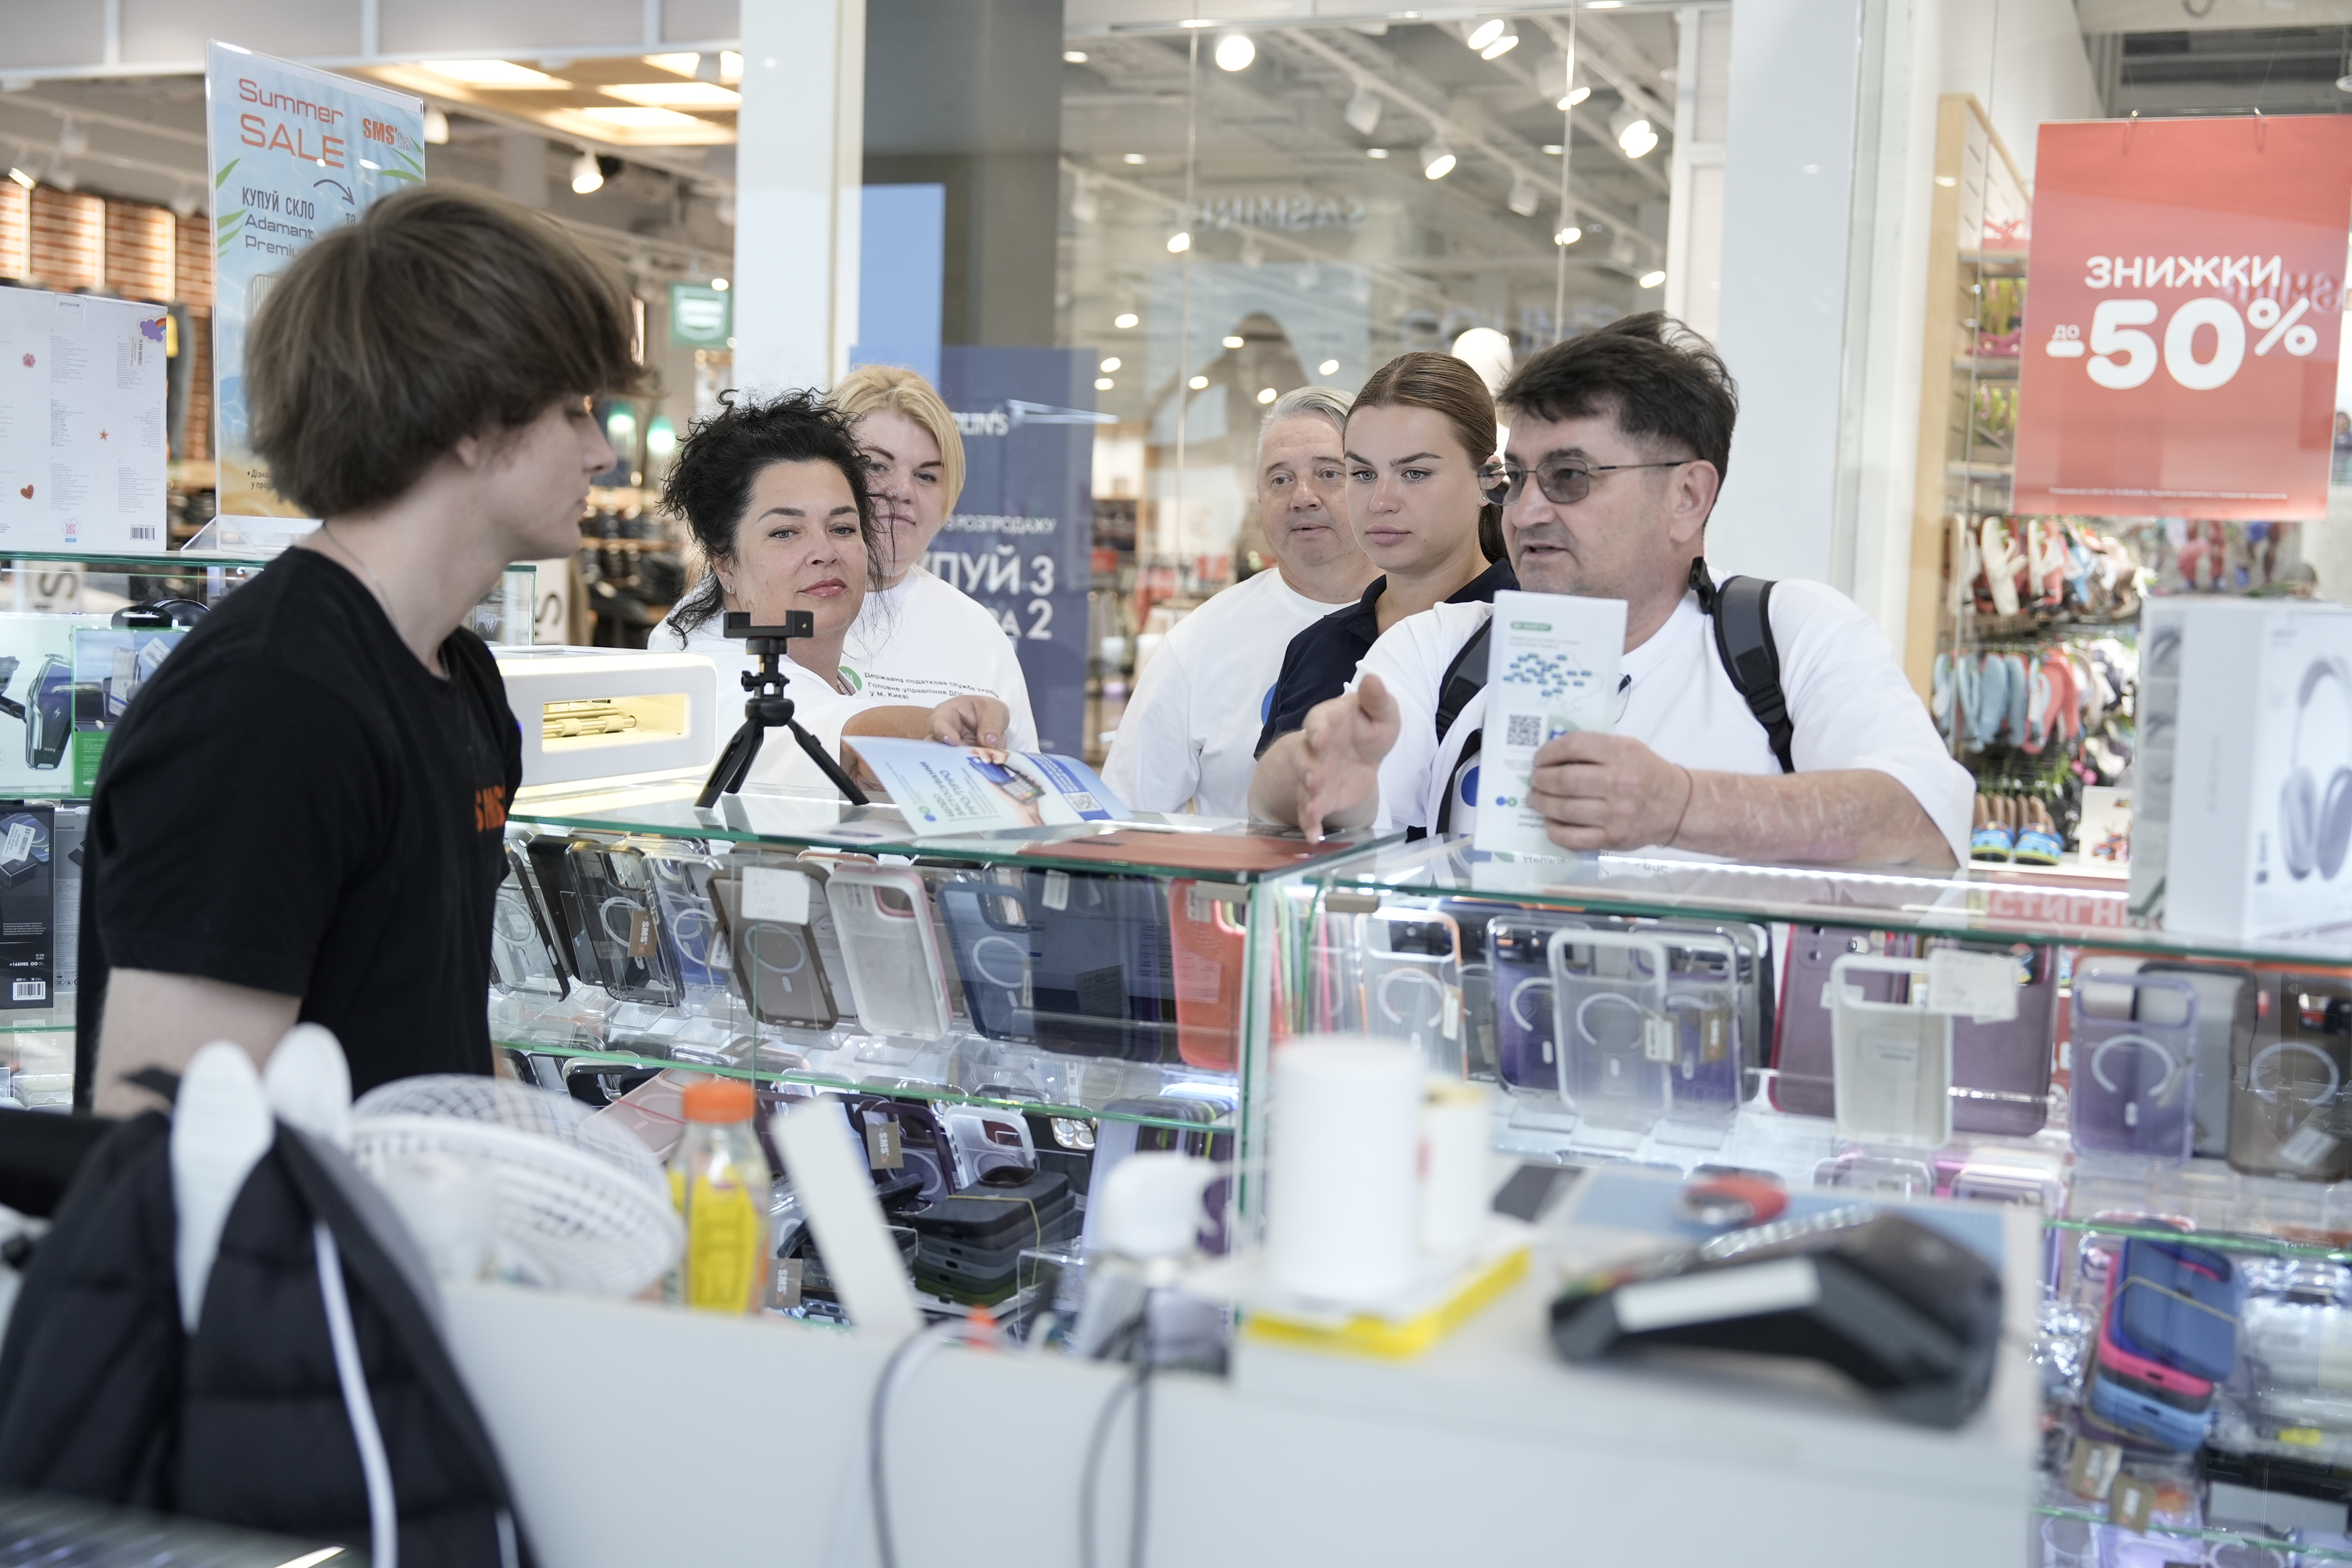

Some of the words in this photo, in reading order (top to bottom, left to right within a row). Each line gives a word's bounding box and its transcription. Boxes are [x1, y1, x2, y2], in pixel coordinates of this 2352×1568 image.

[239, 78, 344, 125] Summer
[240, 113, 344, 169] SALE
[242, 187, 279, 213] КУПУЙ
[285, 197, 315, 220] СКЛО
[245, 213, 315, 240] Adamant
[2084, 255, 2282, 289] ЗНИЖКИ
[2045, 297, 2318, 391] -50%
[2052, 324, 2080, 341] до
[247, 469, 270, 479] Дізна
[256, 482, 268, 490] про
[1029, 555, 1055, 596] 3
[1027, 599, 1054, 640] 2
[865, 672, 904, 683] Державна
[949, 681, 976, 691] служба
[867, 682, 900, 691] Головне
[901, 687, 947, 696] управління
[888, 691, 910, 699] Києві
[475, 785, 505, 832] SMS
